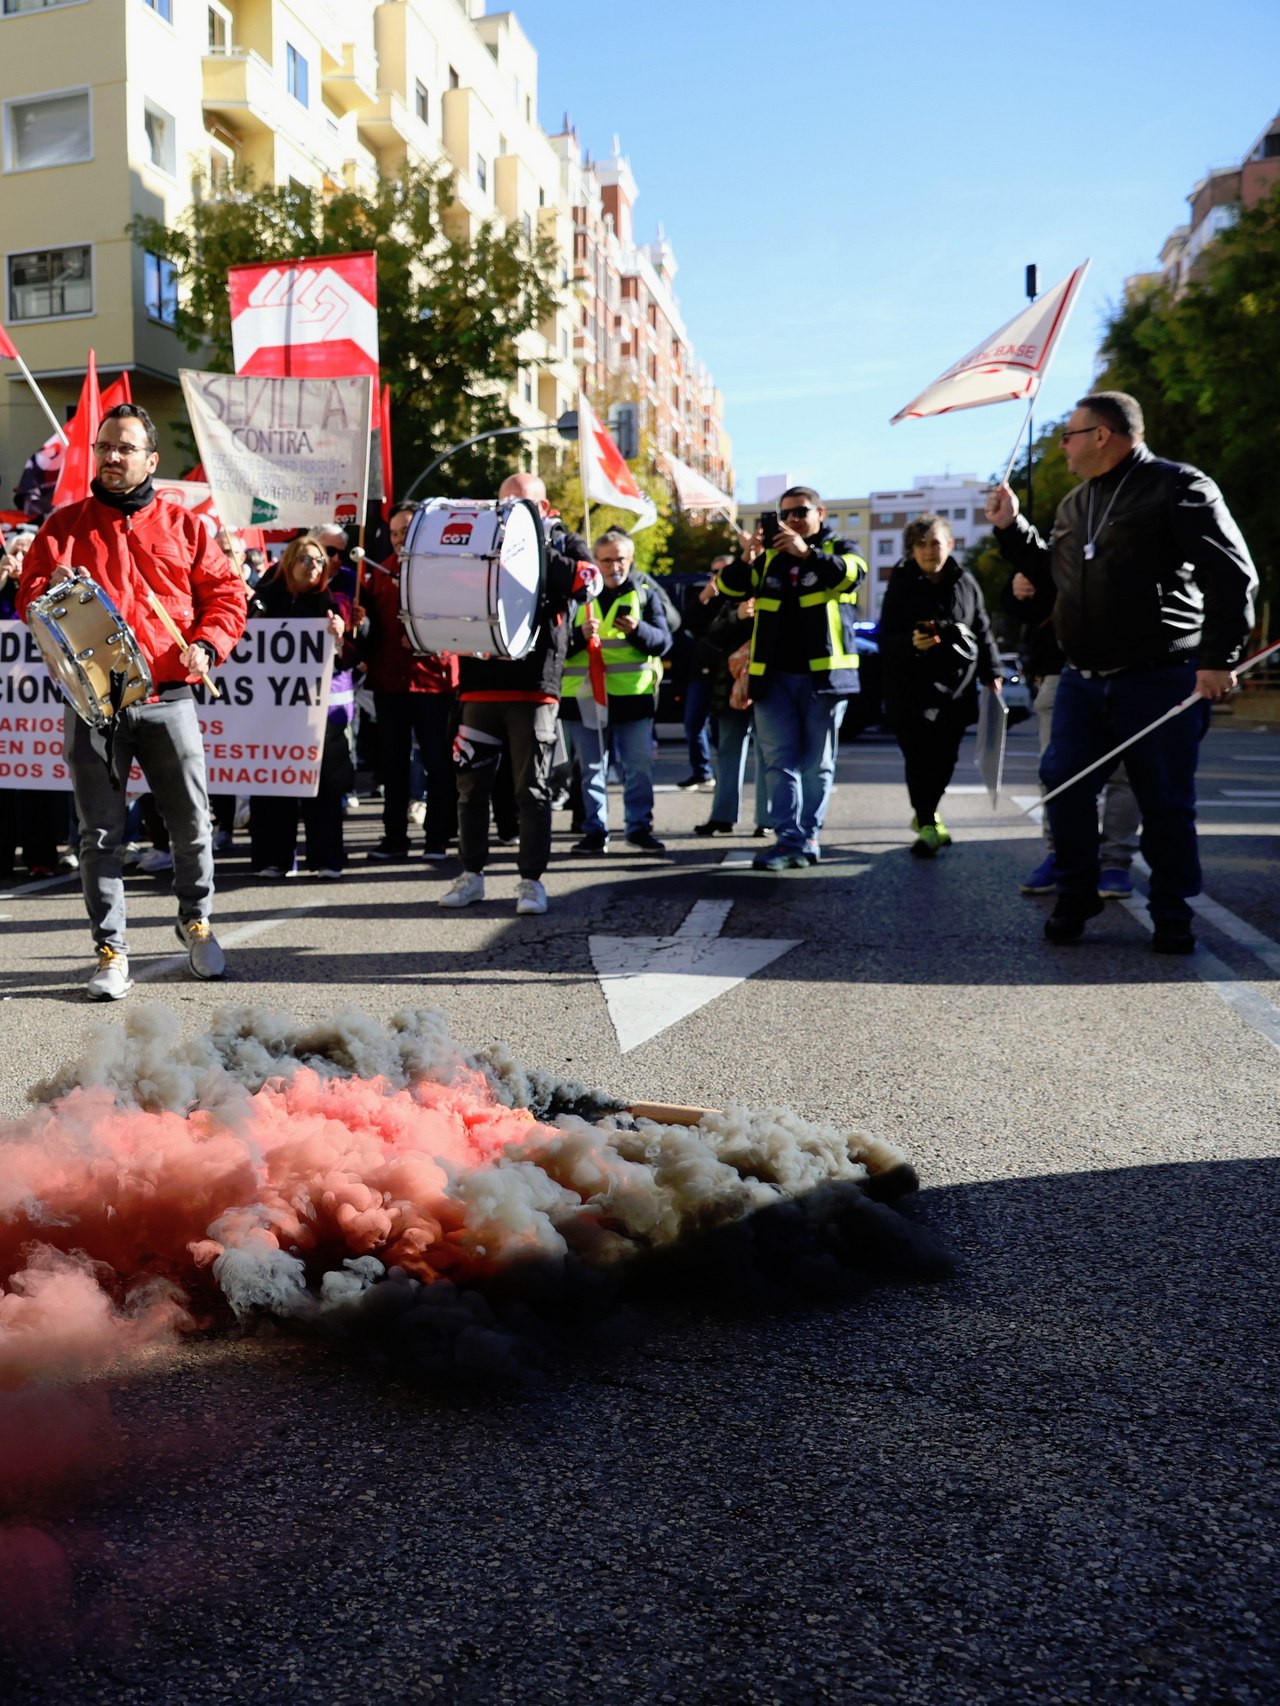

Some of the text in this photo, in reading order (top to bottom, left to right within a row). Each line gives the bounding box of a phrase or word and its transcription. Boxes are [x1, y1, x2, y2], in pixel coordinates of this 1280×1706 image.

[203, 376, 348, 430] SEVILLA
[232, 427, 314, 454] CONTRA
[442, 533, 470, 545] CGT
[223, 621, 324, 664] CIÓN
[267, 676, 323, 706] YA!
[34, 741, 64, 755] DO
